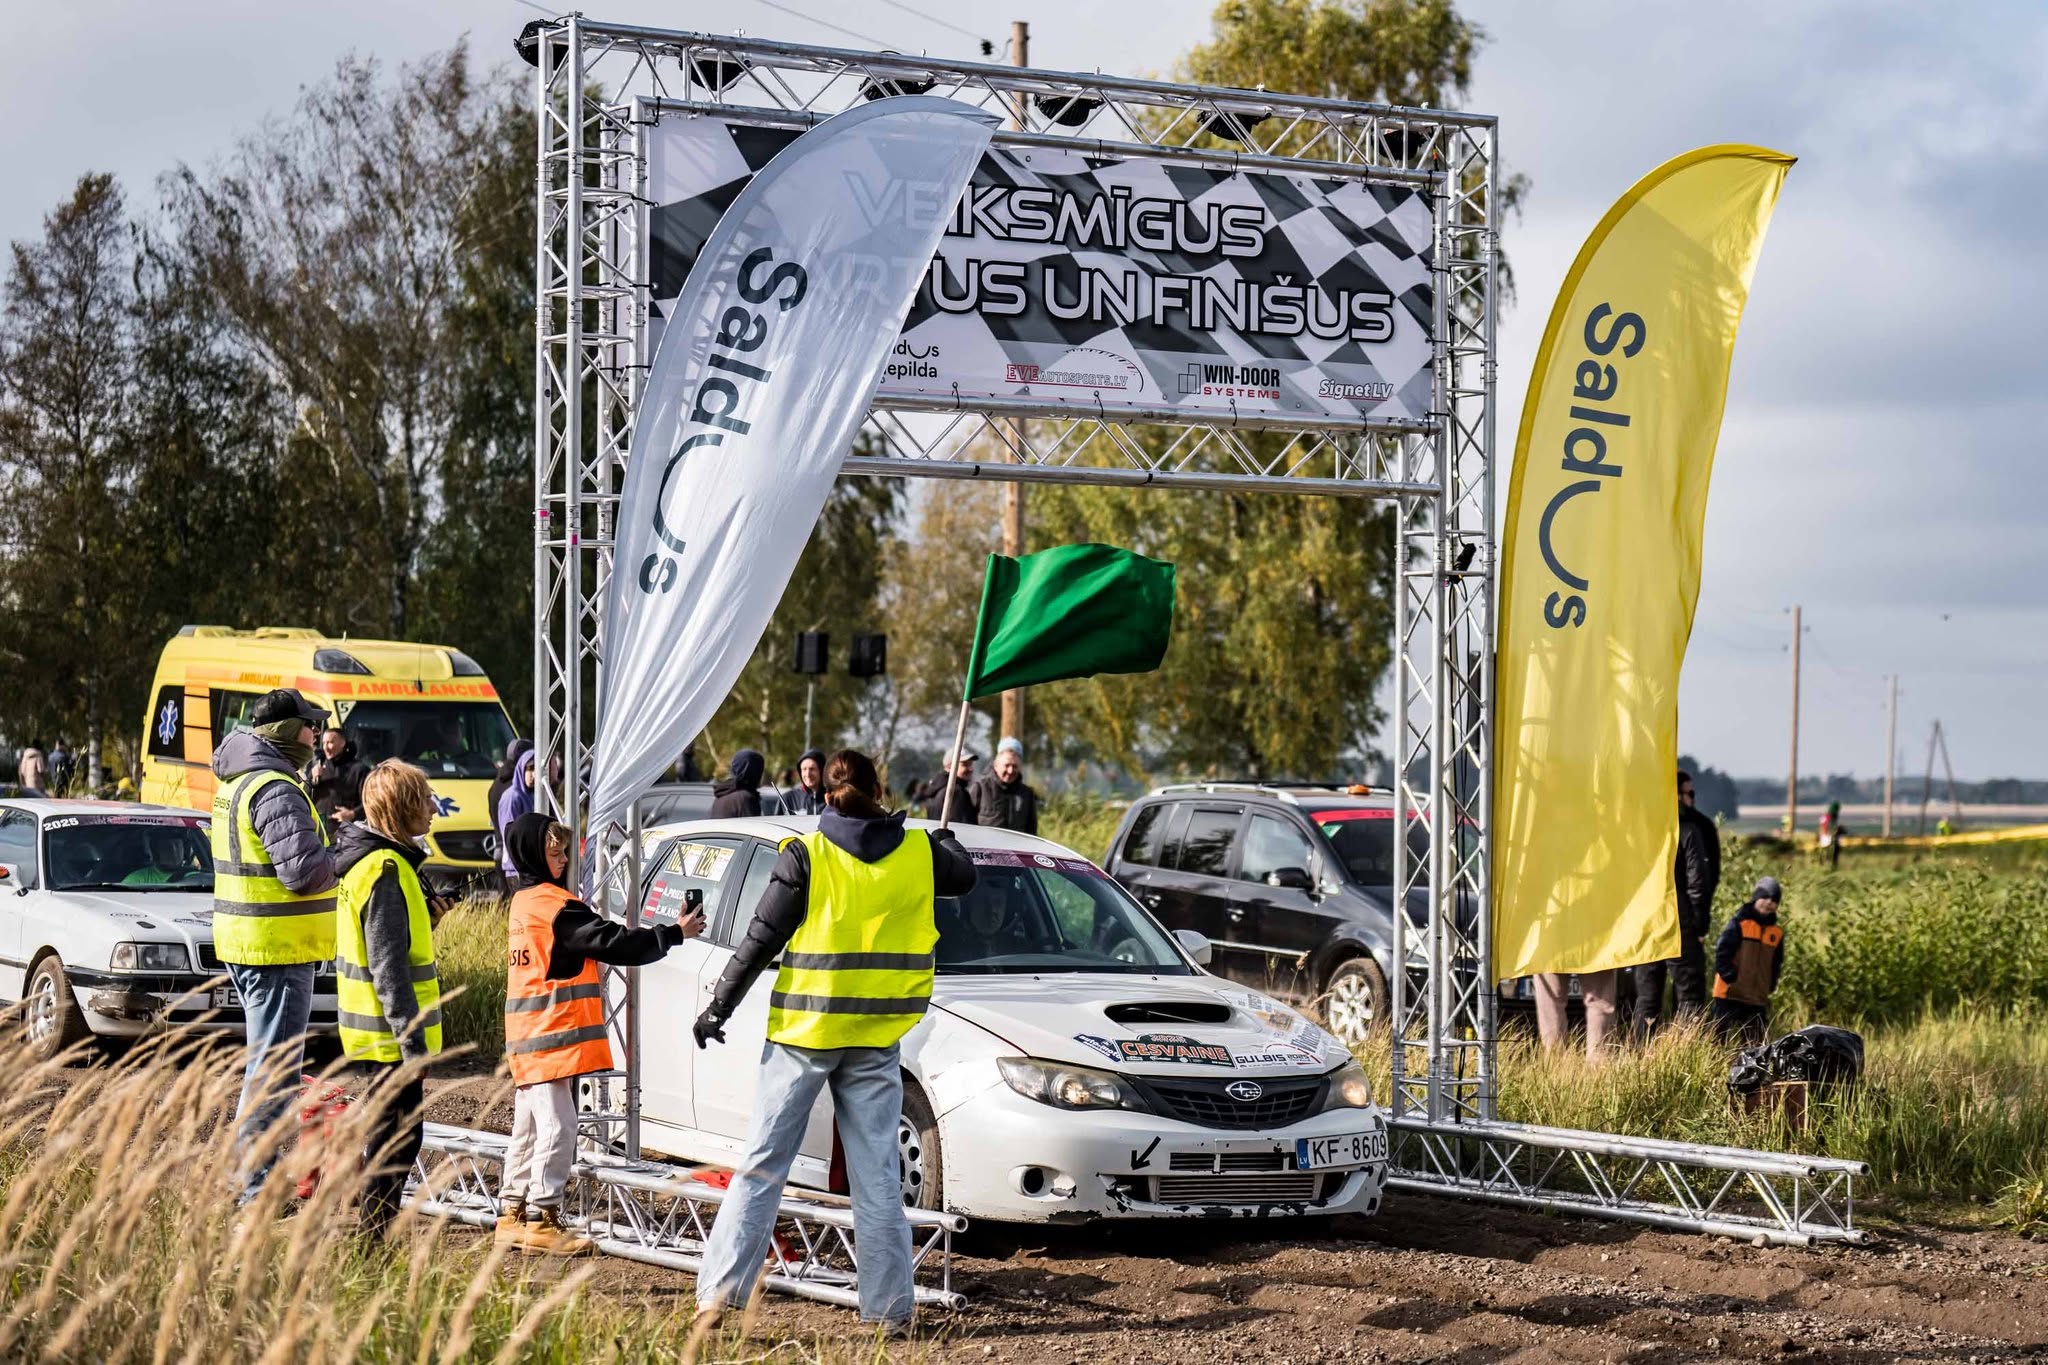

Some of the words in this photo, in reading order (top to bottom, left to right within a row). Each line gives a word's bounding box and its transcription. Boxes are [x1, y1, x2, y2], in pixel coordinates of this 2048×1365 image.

[1042, 264, 1139, 324] UN
[1153, 271, 1394, 342] FINIŠUS
[893, 339, 940, 359] dus
[884, 360, 938, 380] epilda
[1203, 364, 1281, 387] WIN-DOOR
[1203, 386, 1281, 399] SYSTEMS
[43, 817, 80, 831] 2025
[1121, 1041, 1230, 1061] CESVAINE
[1235, 1054, 1287, 1064] GULBIS
